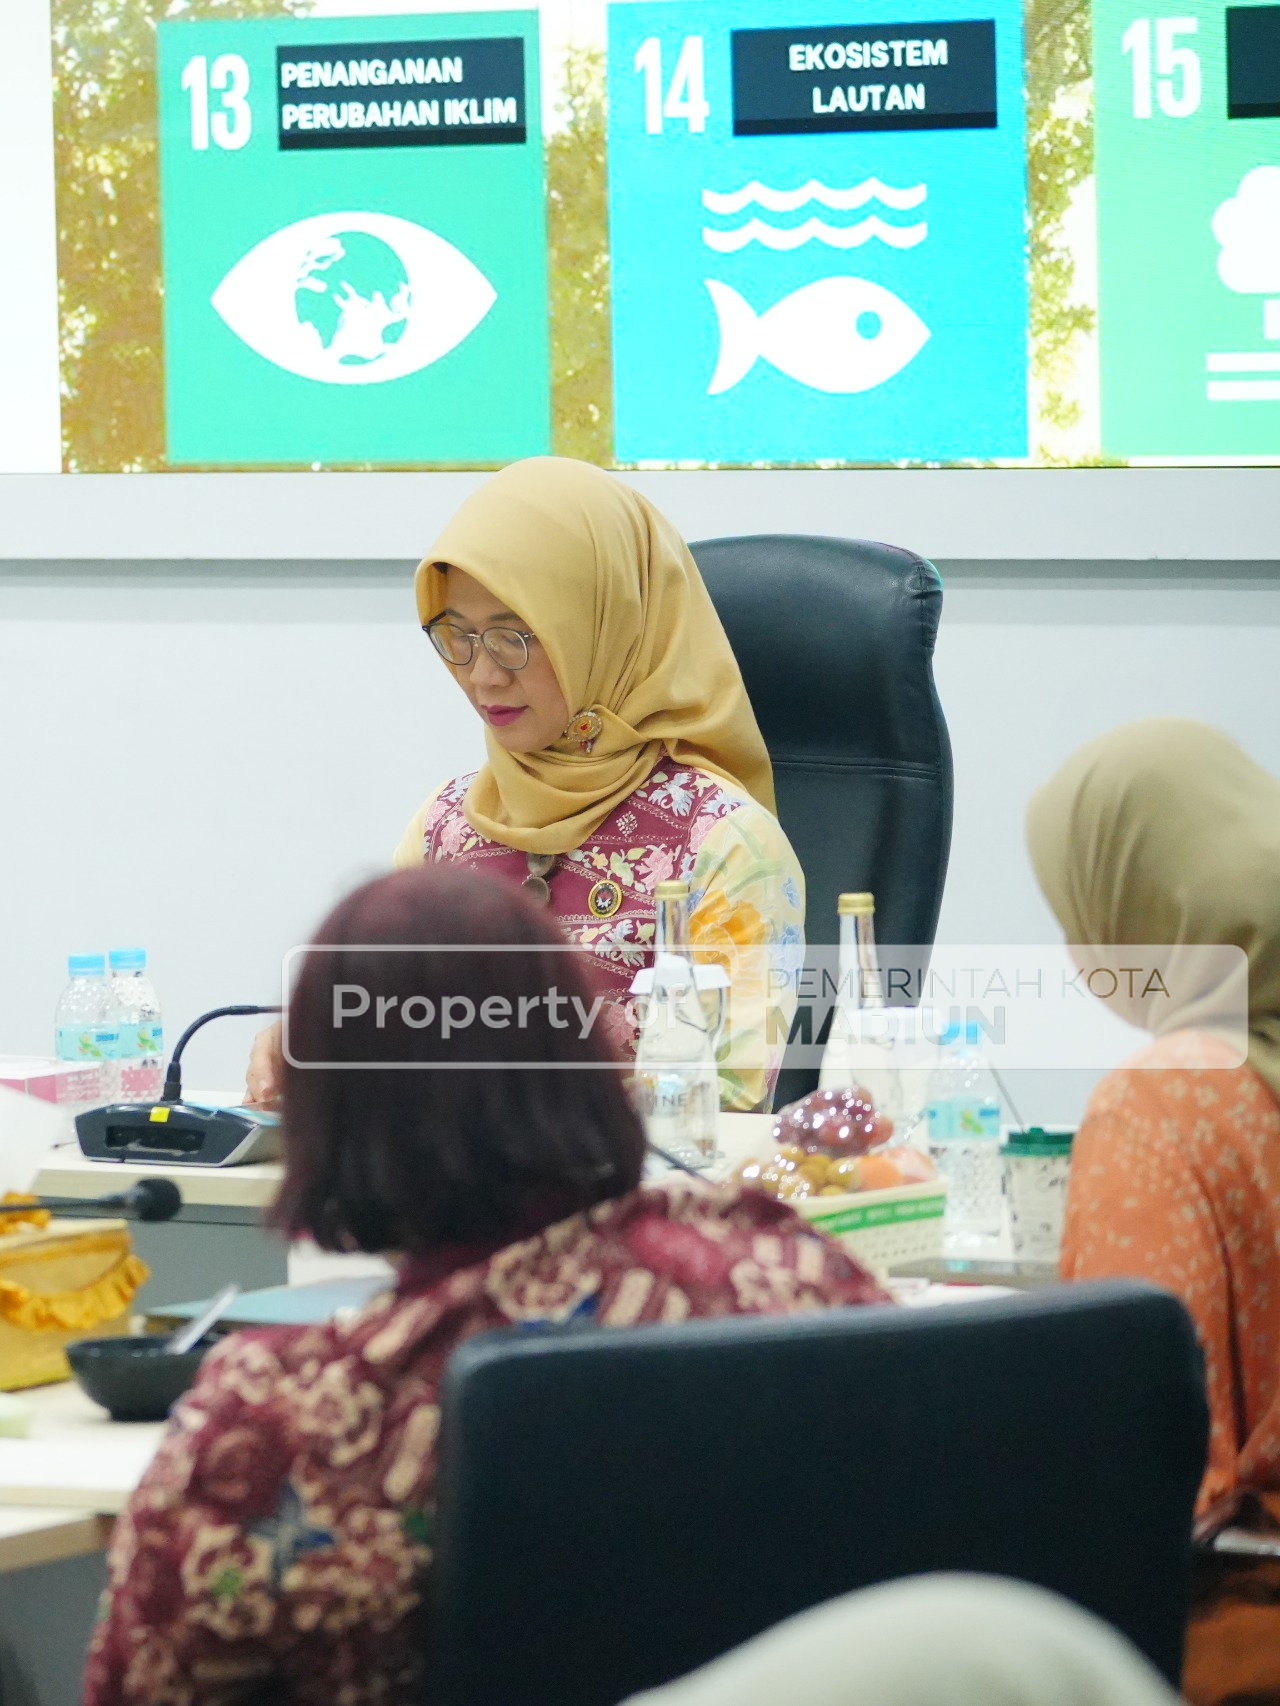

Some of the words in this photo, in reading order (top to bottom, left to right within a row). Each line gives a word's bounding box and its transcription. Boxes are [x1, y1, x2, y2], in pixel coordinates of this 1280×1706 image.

[788, 39, 949, 72] EKOSISTEM
[1120, 17, 1202, 119] 15
[280, 57, 464, 89] PENANGANAN
[633, 35, 710, 135] 14
[181, 54, 252, 151] 13
[281, 100, 440, 131] PERUBAHAN
[444, 97, 518, 127] IKLIM
[812, 83, 926, 114] LAUTAN
